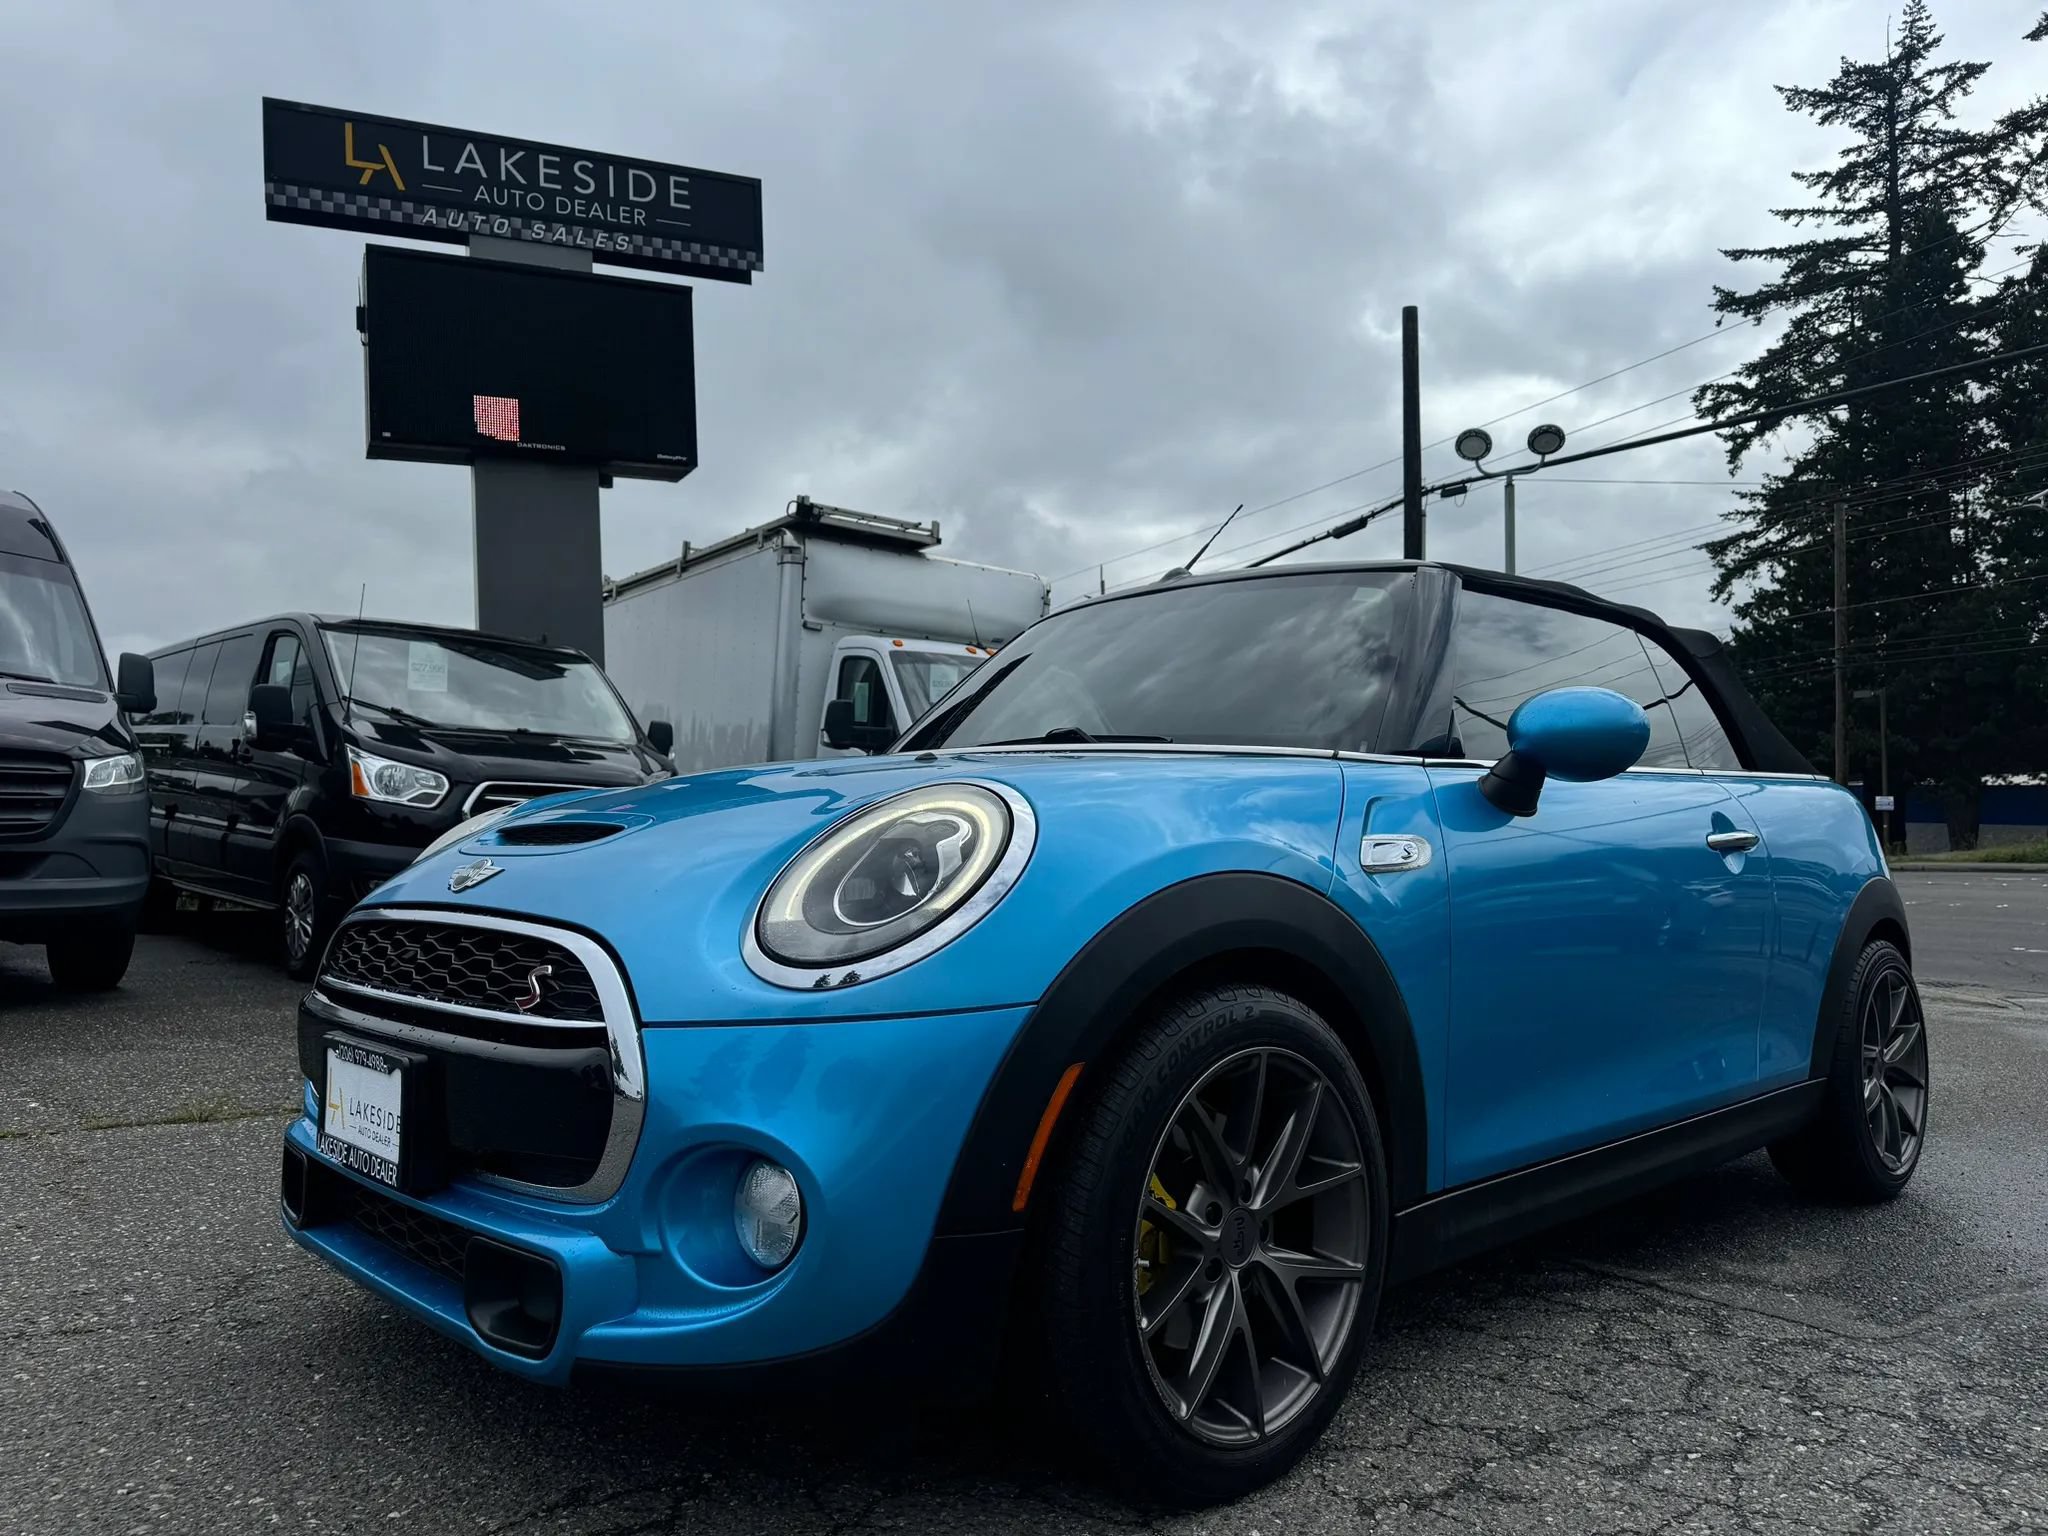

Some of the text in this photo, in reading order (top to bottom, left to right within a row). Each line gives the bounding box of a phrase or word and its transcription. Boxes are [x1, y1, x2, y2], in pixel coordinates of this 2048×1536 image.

[422, 135, 691, 209] LAKESIDE
[422, 208, 629, 251] AUTO SALES
[473, 184, 648, 228] AUTO DEALER
[1157, 1008, 1240, 1084] CONTROL
[1244, 1005, 1255, 1019] 2
[349, 1097, 401, 1134] LAKESIDE
[318, 1132, 398, 1188] LAKESIDE AUTO DEALER
